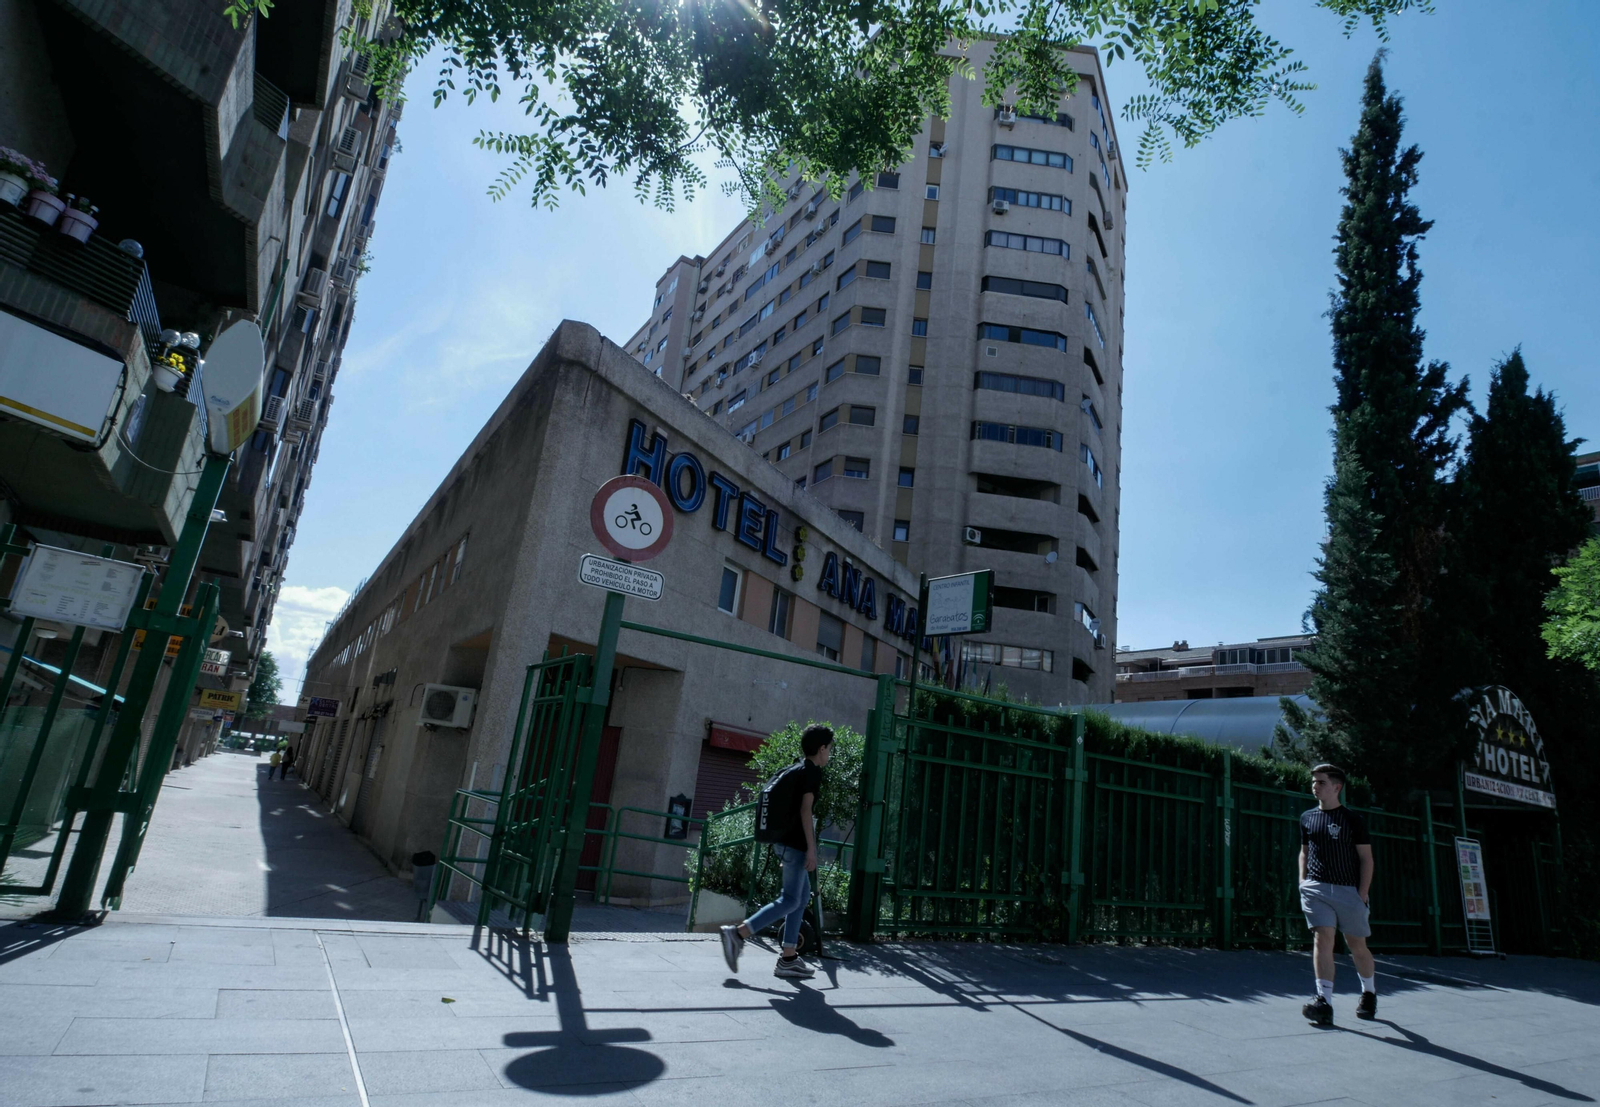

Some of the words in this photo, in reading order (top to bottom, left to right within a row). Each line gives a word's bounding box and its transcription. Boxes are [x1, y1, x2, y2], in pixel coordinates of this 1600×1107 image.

[621, 418, 787, 567] HOTEL
[817, 551, 877, 620] ANA
[583, 573, 600, 583] TODO
[637, 587, 658, 597] MOTOR
[590, 567, 624, 581] PROHIBIDO
[624, 576, 631, 584] EL
[632, 578, 648, 587] PASO
[634, 570, 658, 582] PRIVADA
[933, 582, 950, 591] CENTRO
[950, 580, 970, 588] INFANTIL
[930, 611, 968, 624] Garabatos
[1484, 742, 1541, 784] HOTEL
